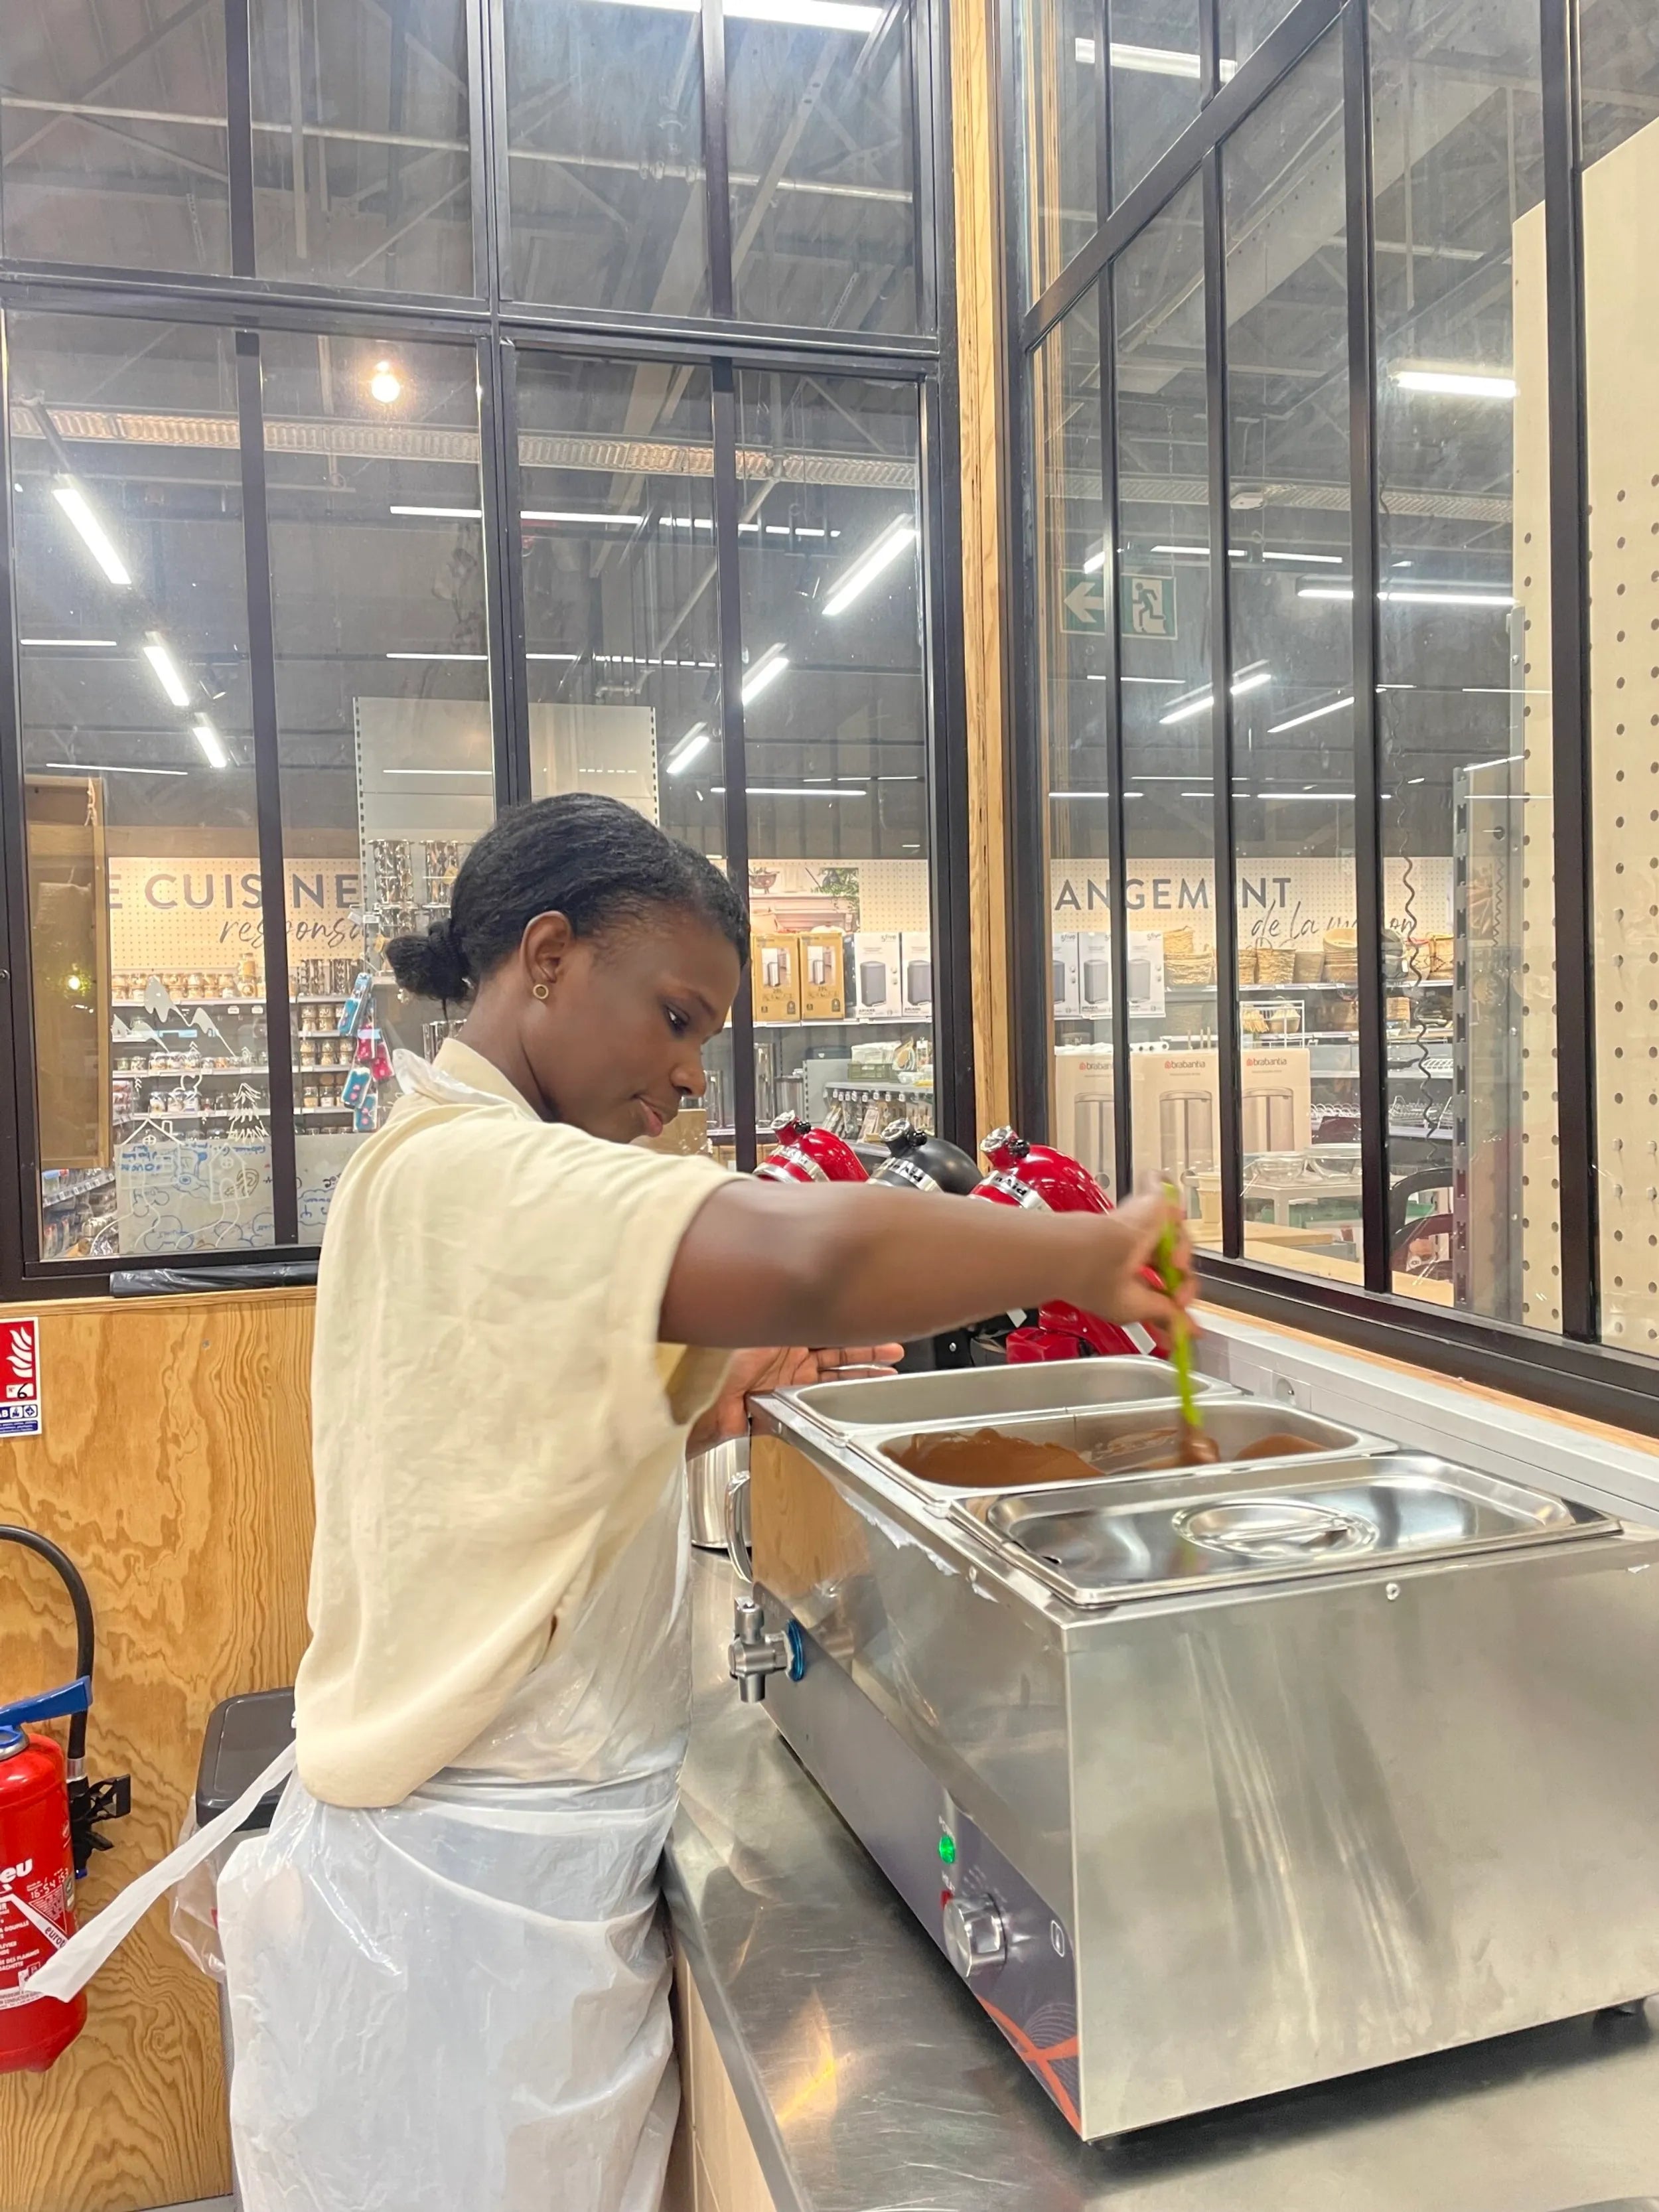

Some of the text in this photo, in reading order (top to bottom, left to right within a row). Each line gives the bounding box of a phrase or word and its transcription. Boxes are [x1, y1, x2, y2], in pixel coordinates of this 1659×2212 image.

[145, 873, 359, 910] CUISNE
[1054, 877, 1291, 911] ANGEMNT
[1252, 899, 1281, 947] de
[1291, 901, 1319, 940] la
[1171, 1060, 1205, 1069] brabantia
[1253, 1057, 1287, 1067] brabantia
[17, 1382, 28, 1399] 6
